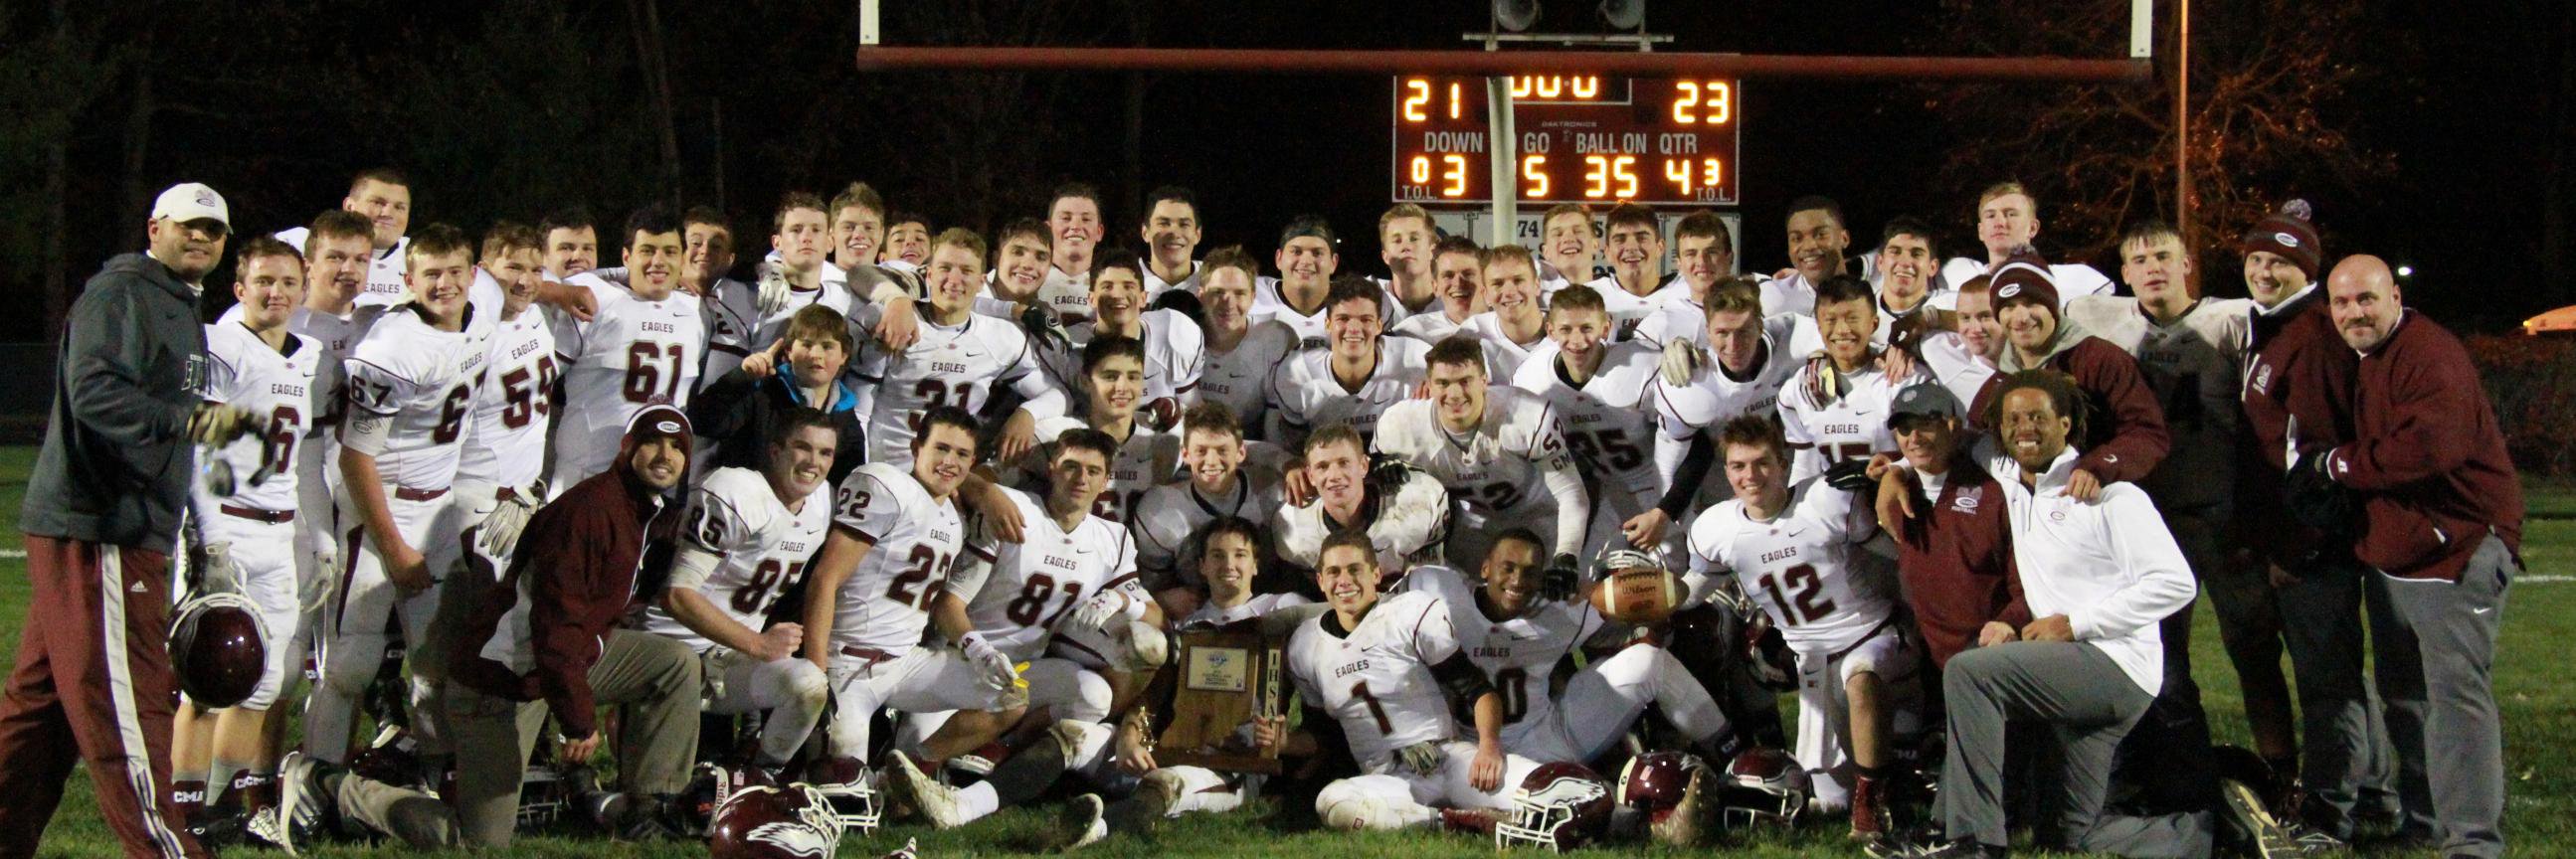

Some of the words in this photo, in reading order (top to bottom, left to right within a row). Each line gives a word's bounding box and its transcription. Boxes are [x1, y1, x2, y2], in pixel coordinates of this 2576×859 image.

[1675, 82, 1729, 123] 23
[1424, 131, 1483, 153] DOWN
[1524, 132, 1550, 154] GO
[1575, 133, 1618, 154] BALL
[1623, 133, 1647, 154] ON
[1660, 133, 1697, 155] QTR
[1443, 155, 1466, 197] 3
[1524, 155, 1549, 197] 5
[1585, 156, 1638, 198] 35
[1665, 159, 1691, 196] 4
[1704, 159, 1721, 186] 3
[1518, 221, 1540, 238] 74
[364, 283, 400, 294] EAGLES
[1054, 295, 1088, 305] EAGLES
[642, 321, 674, 333] EAGLES
[511, 338, 539, 360] EAGLES
[460, 352, 483, 374] EAGLES
[624, 340, 684, 404] 61
[932, 361, 966, 374] EAGLES
[272, 383, 304, 398] EAGLES
[350, 375, 392, 408] 67
[501, 354, 557, 430] 59
[1197, 381, 1230, 395] EAGLES
[1744, 395, 1776, 414] EAGLES
[1343, 414, 1378, 426] EAGLES
[1571, 413, 1601, 424] EAGLES
[1824, 424, 1859, 434] EAGLES
[263, 405, 300, 474] 6
[1109, 470, 1138, 481] EAGLES
[836, 487, 871, 520] 22
[780, 540, 806, 553] EAGLES
[930, 528, 951, 545] EAGLES
[1044, 555, 1076, 571] EAGLES
[1760, 546, 1797, 565] EAGLES
[886, 544, 952, 612] 22
[1007, 572, 1084, 629] 81
[1758, 562, 1837, 627] 12
[1474, 647, 1511, 658] EAGLES
[1335, 659, 1371, 678] EAGLES
[1350, 679, 1394, 736] 1
